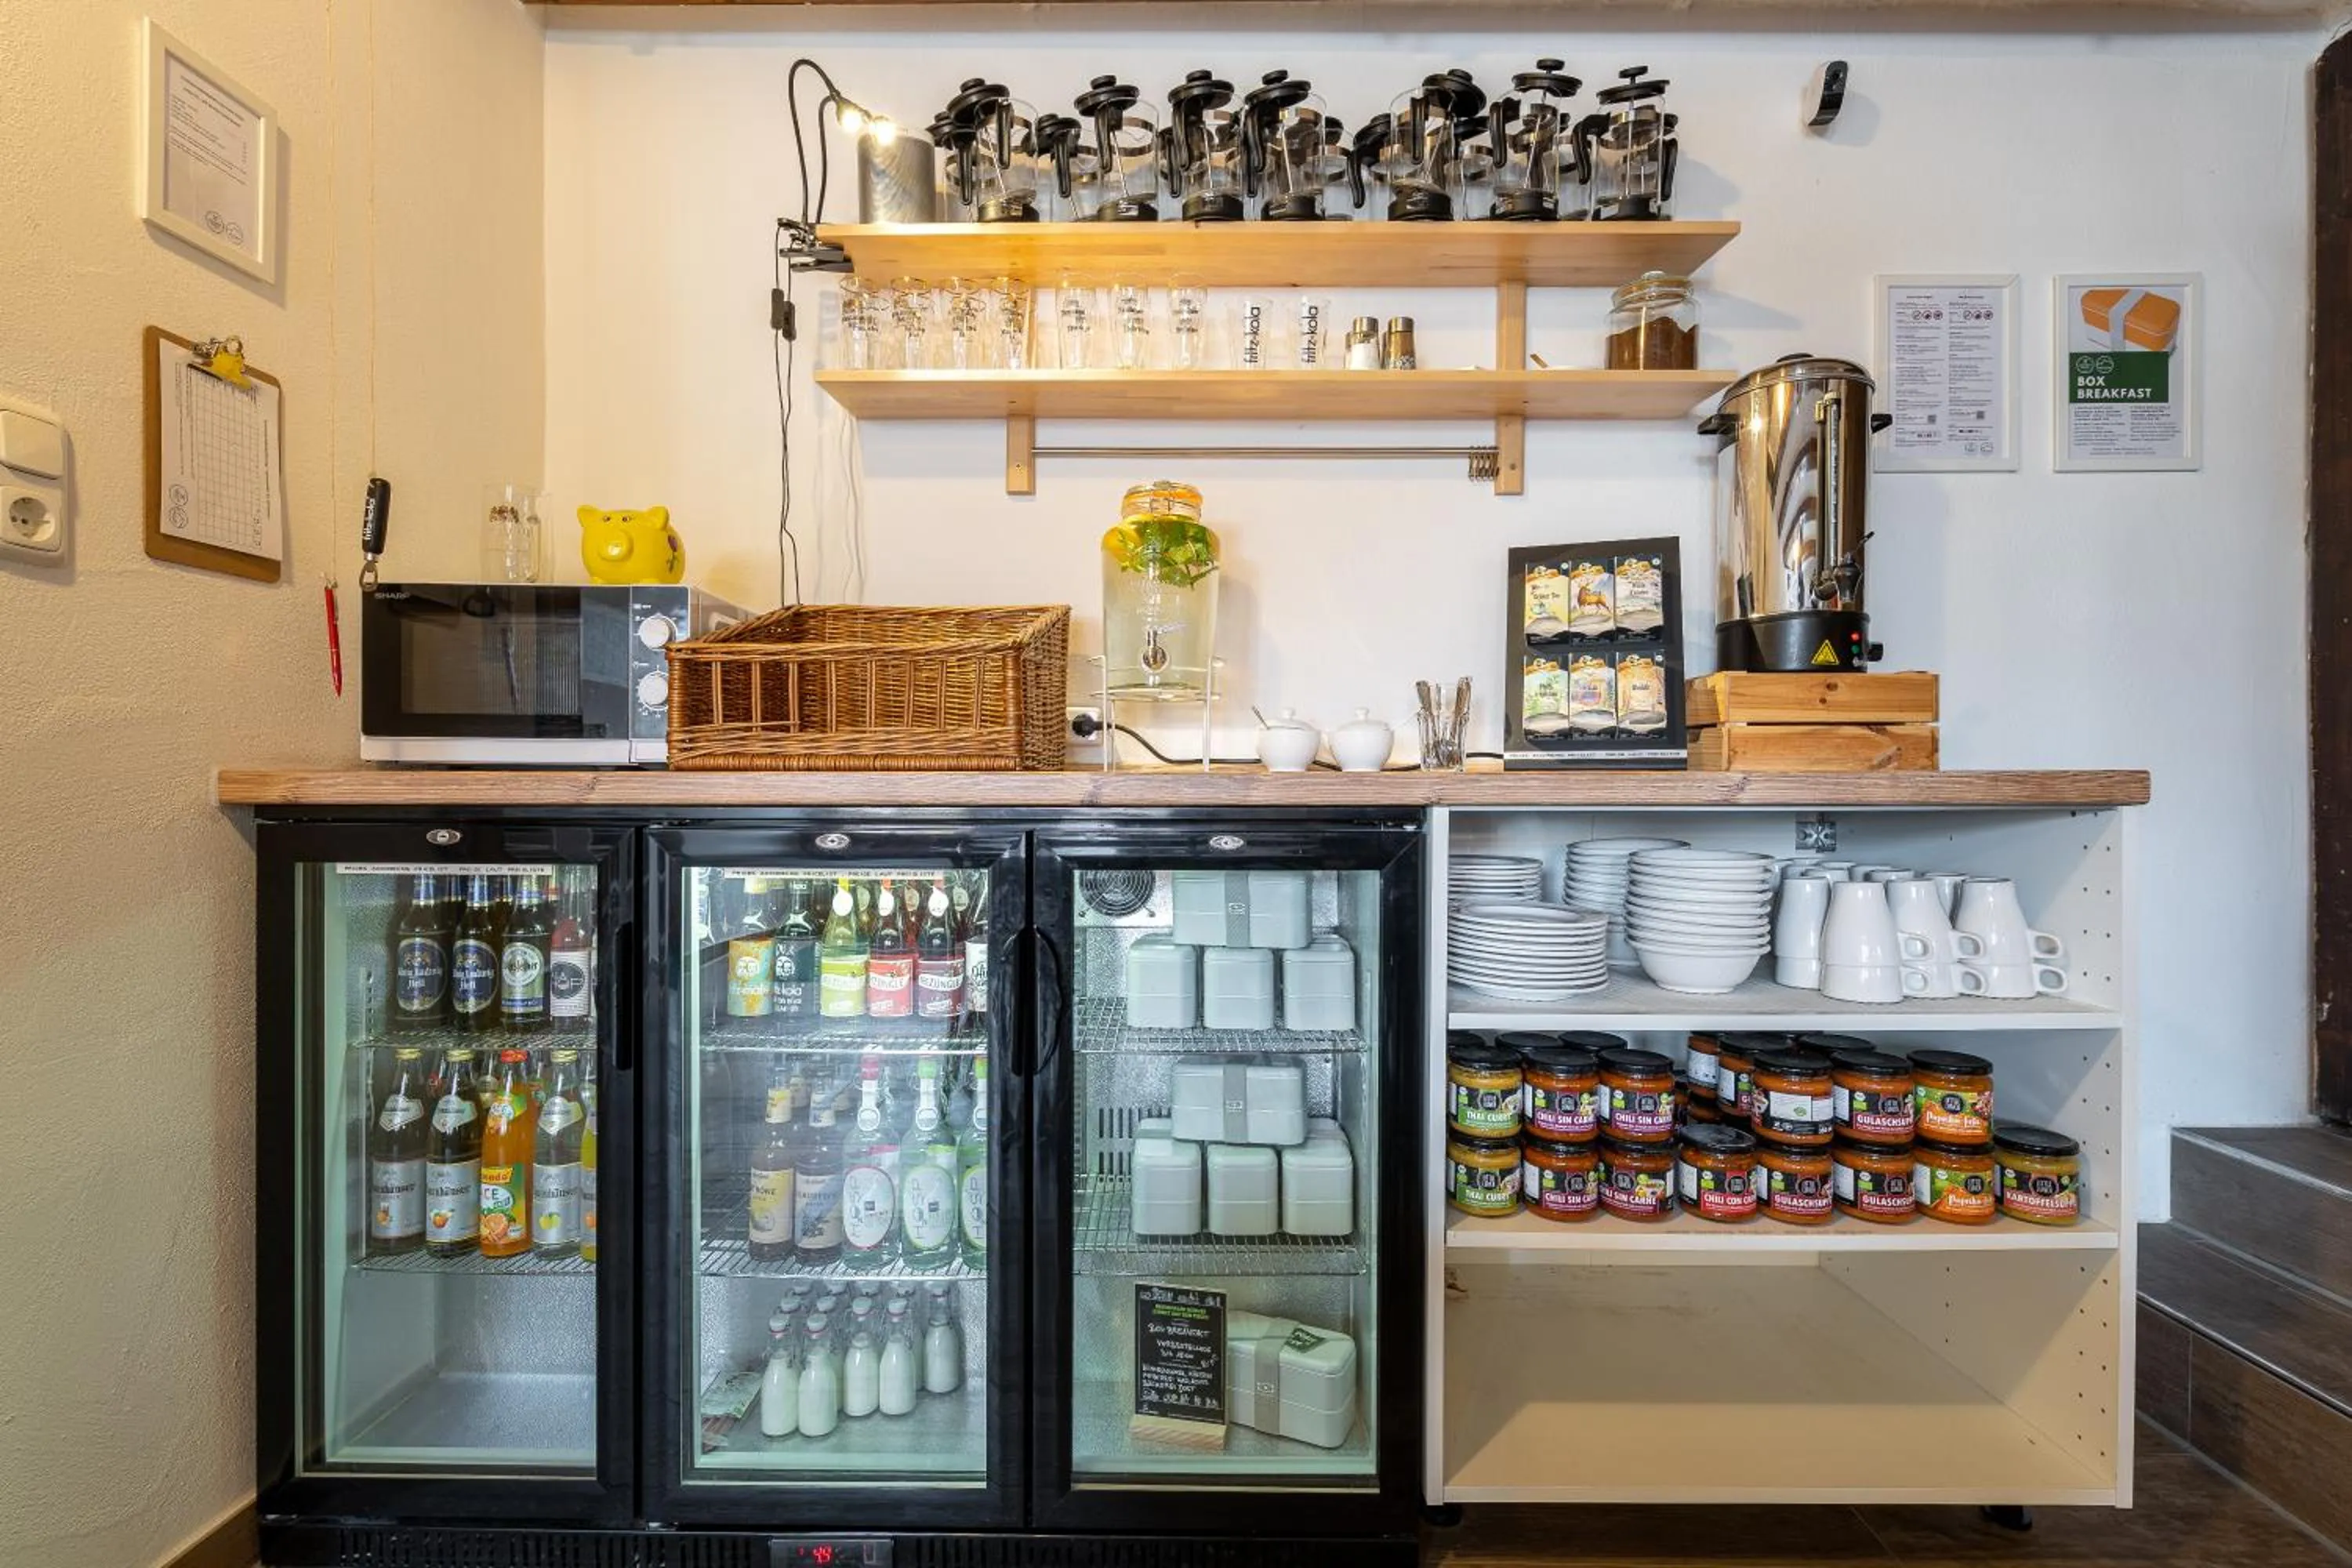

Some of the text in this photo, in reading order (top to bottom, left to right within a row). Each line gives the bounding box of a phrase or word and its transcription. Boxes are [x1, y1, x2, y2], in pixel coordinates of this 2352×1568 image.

[1243, 307, 1261, 363] fritz-kola
[1301, 306, 1319, 363] fritz-kola
[2077, 376, 2105, 387] BOX
[2077, 388, 2152, 399] BREAKFAST
[1467, 1111, 1486, 1120] THAI
[1558, 1114, 1572, 1123] SIN
[1615, 1112, 1635, 1123] CHILI
[1638, 1116, 1652, 1124] SIN
[1567, 1195, 1581, 1203] SIN
[1629, 1195, 1657, 1205] CARNE
[1726, 1196, 1743, 1205] CON
[1774, 1193, 1832, 1207] GULASCHSUPP
